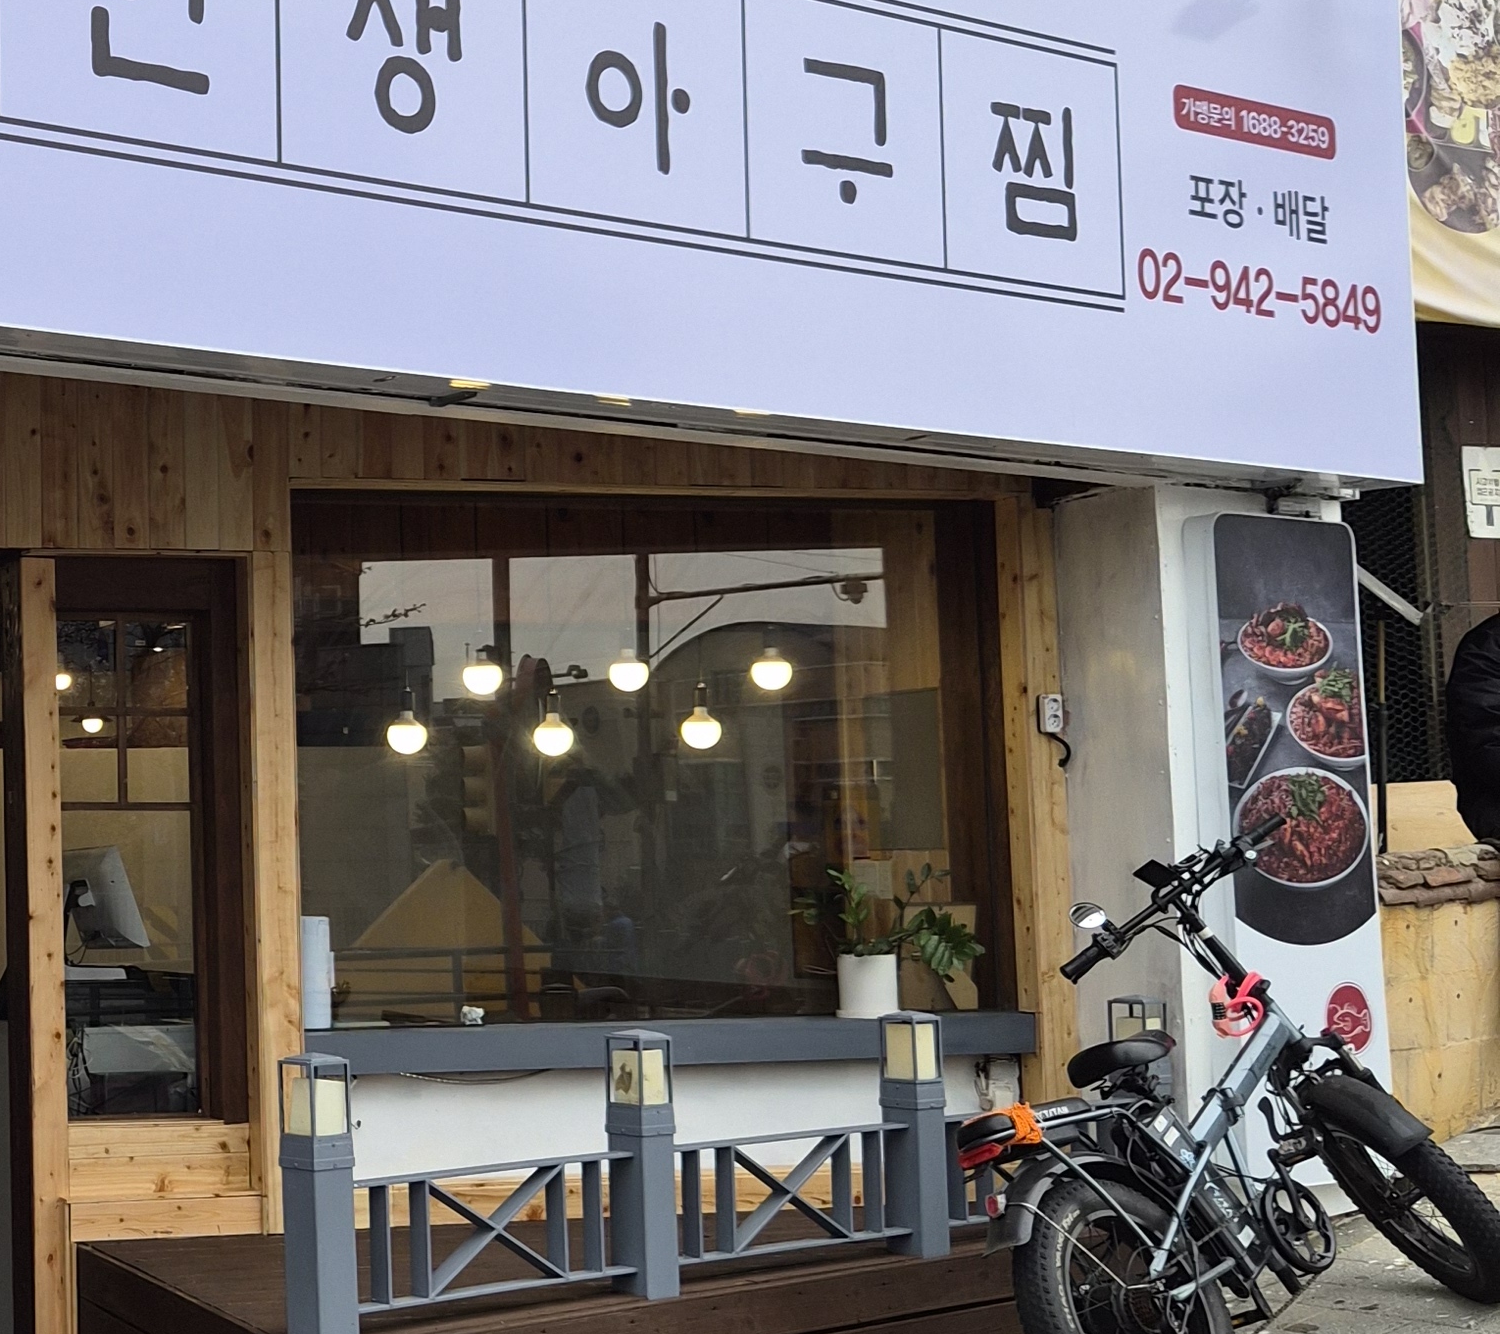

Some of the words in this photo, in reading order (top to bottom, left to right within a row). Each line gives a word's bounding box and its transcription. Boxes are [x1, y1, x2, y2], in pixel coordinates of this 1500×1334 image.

[1180, 98, 1236, 131] 가맹문의
[1239, 109, 1330, 149] 1688-3259
[1137, 247, 1382, 334] 02-942-5849
